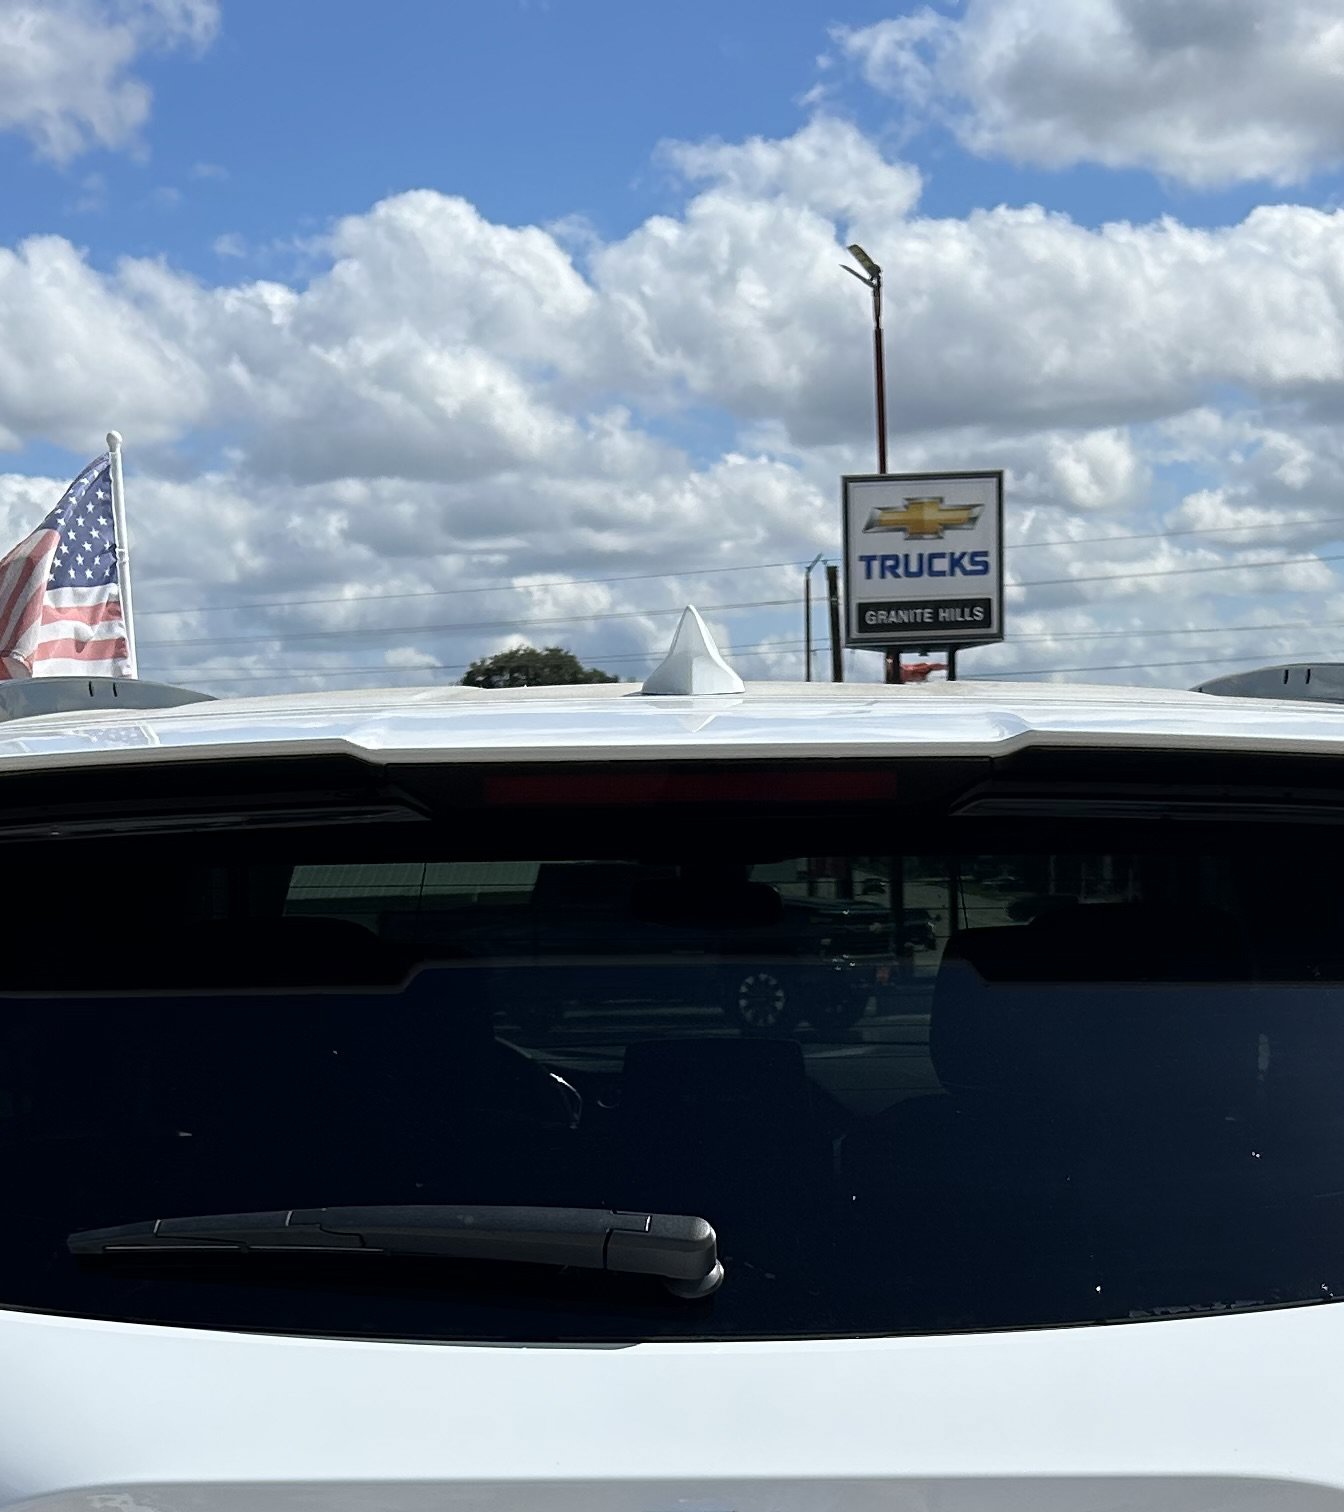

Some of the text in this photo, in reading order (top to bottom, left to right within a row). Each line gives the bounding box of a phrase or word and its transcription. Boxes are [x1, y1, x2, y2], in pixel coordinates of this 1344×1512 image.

[859, 551, 990, 580] TRUCKS
[865, 606, 984, 625] GRANITE HILLS
